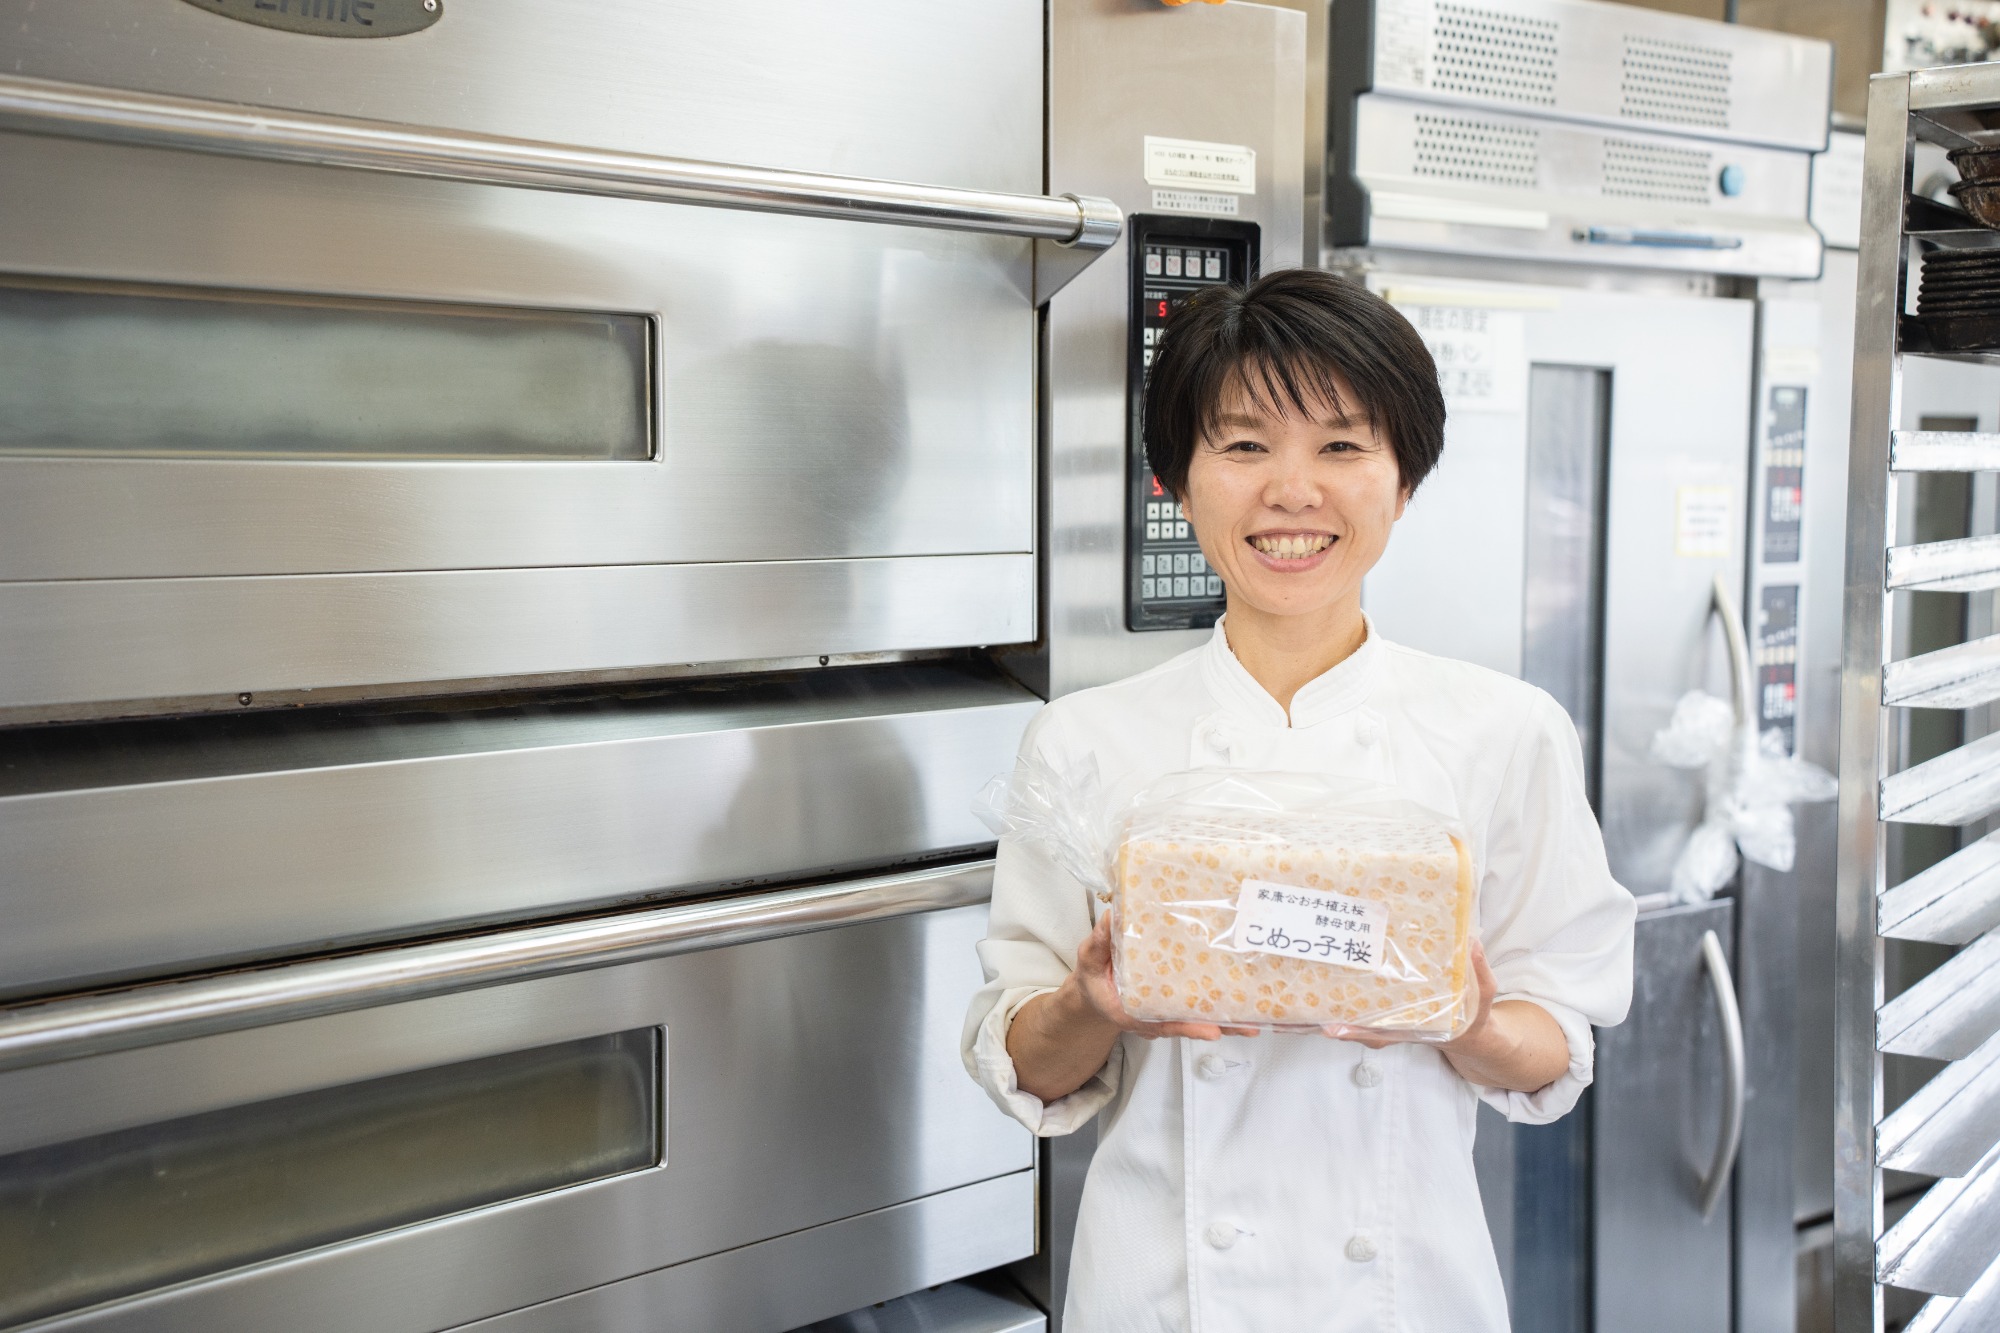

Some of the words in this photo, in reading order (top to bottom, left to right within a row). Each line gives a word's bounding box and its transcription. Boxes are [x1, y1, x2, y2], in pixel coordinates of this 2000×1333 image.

[1157, 301, 1168, 318] 5
[1257, 888, 1365, 917] 家康公お手植え桜
[1315, 914, 1371, 934] 酵母使用
[1246, 924, 1372, 964] こめっ子桜
